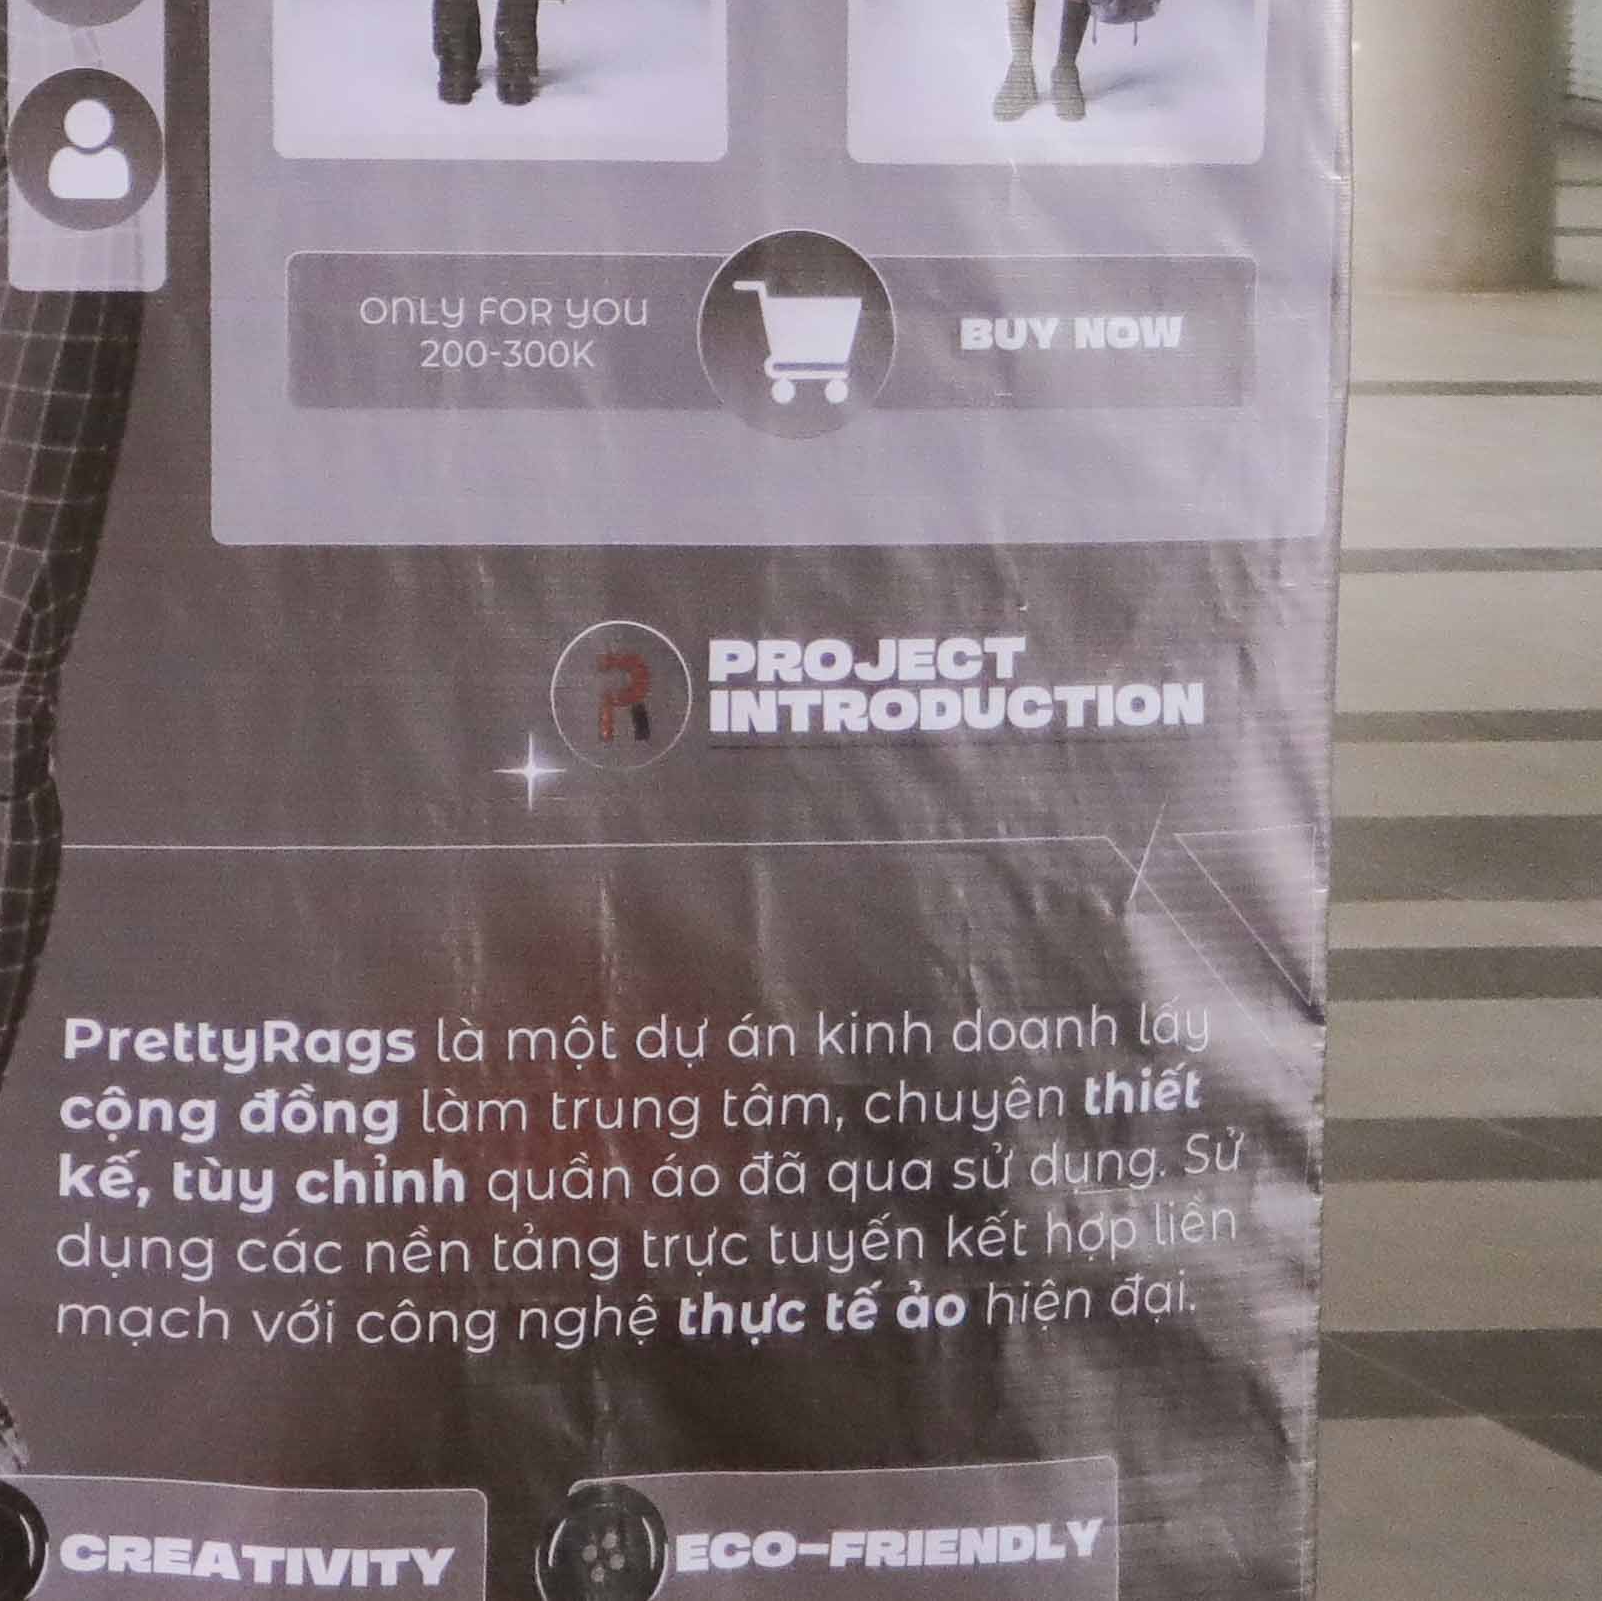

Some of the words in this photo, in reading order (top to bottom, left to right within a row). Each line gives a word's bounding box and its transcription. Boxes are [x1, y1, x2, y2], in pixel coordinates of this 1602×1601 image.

[359, 296, 465, 328] ONLY
[479, 297, 553, 326] FOR
[565, 296, 648, 330] YOU
[959, 316, 1060, 351] BUY
[1074, 315, 1185, 350] NOW
[419, 339, 596, 369] 200-300K
[707, 636, 1027, 683] PROJECT
[708, 681, 1205, 736] INTRODUCTION
[62, 1016, 416, 1075] PrettyRags
[436, 1016, 484, 1063] là
[507, 1015, 617, 1070] một
[636, 1013, 708, 1069] dự
[727, 1013, 796, 1058] án
[817, 1009, 933, 1056] kinh
[952, 1002, 1117, 1053] doanh
[59, 1085, 217, 1143] cộng
[239, 1082, 399, 1144] đồng
[421, 1087, 527, 1134] làm
[551, 1087, 699, 1139] trung
[721, 1083, 846, 1134] tâm,
[863, 1074, 1065, 1133] chuyên
[1083, 1061, 1202, 1118] thiết
[57, 1147, 151, 1209] kế,
[171, 1155, 274, 1211] tùy
[294, 1152, 466, 1204] chỉnh
[486, 1150, 632, 1211] quần
[651, 1152, 719, 1199] áo
[737, 1150, 807, 1196] đã
[826, 1156, 932, 1203] qua
[952, 1142, 1014, 1190] sử
[1029, 1141, 1167, 1195] dụng.
[1183, 1125, 1246, 1175] Sử
[55, 1222, 215, 1282] dụng
[236, 1226, 344, 1275] các
[364, 1223, 471, 1274] nền
[493, 1221, 620, 1280] tảng
[643, 1226, 749, 1277] trực
[769, 1211, 925, 1274] tuyến
[946, 1210, 1029, 1259] kết
[1044, 1202, 1137, 1264] hợp
[55, 1295, 230, 1347] mạch
[251, 1297, 335, 1344] với
[355, 1300, 497, 1353] công
[517, 1292, 659, 1349] nghệ
[677, 1290, 807, 1347] thực
[825, 1279, 883, 1332] tế
[895, 1278, 968, 1330] ảo
[984, 1276, 1093, 1332] hiện
[1109, 1269, 1198, 1324] đại.
[58, 1532, 456, 1588] CREATIVITY
[675, 1516, 1104, 1574] ECO-FRIENDLY
